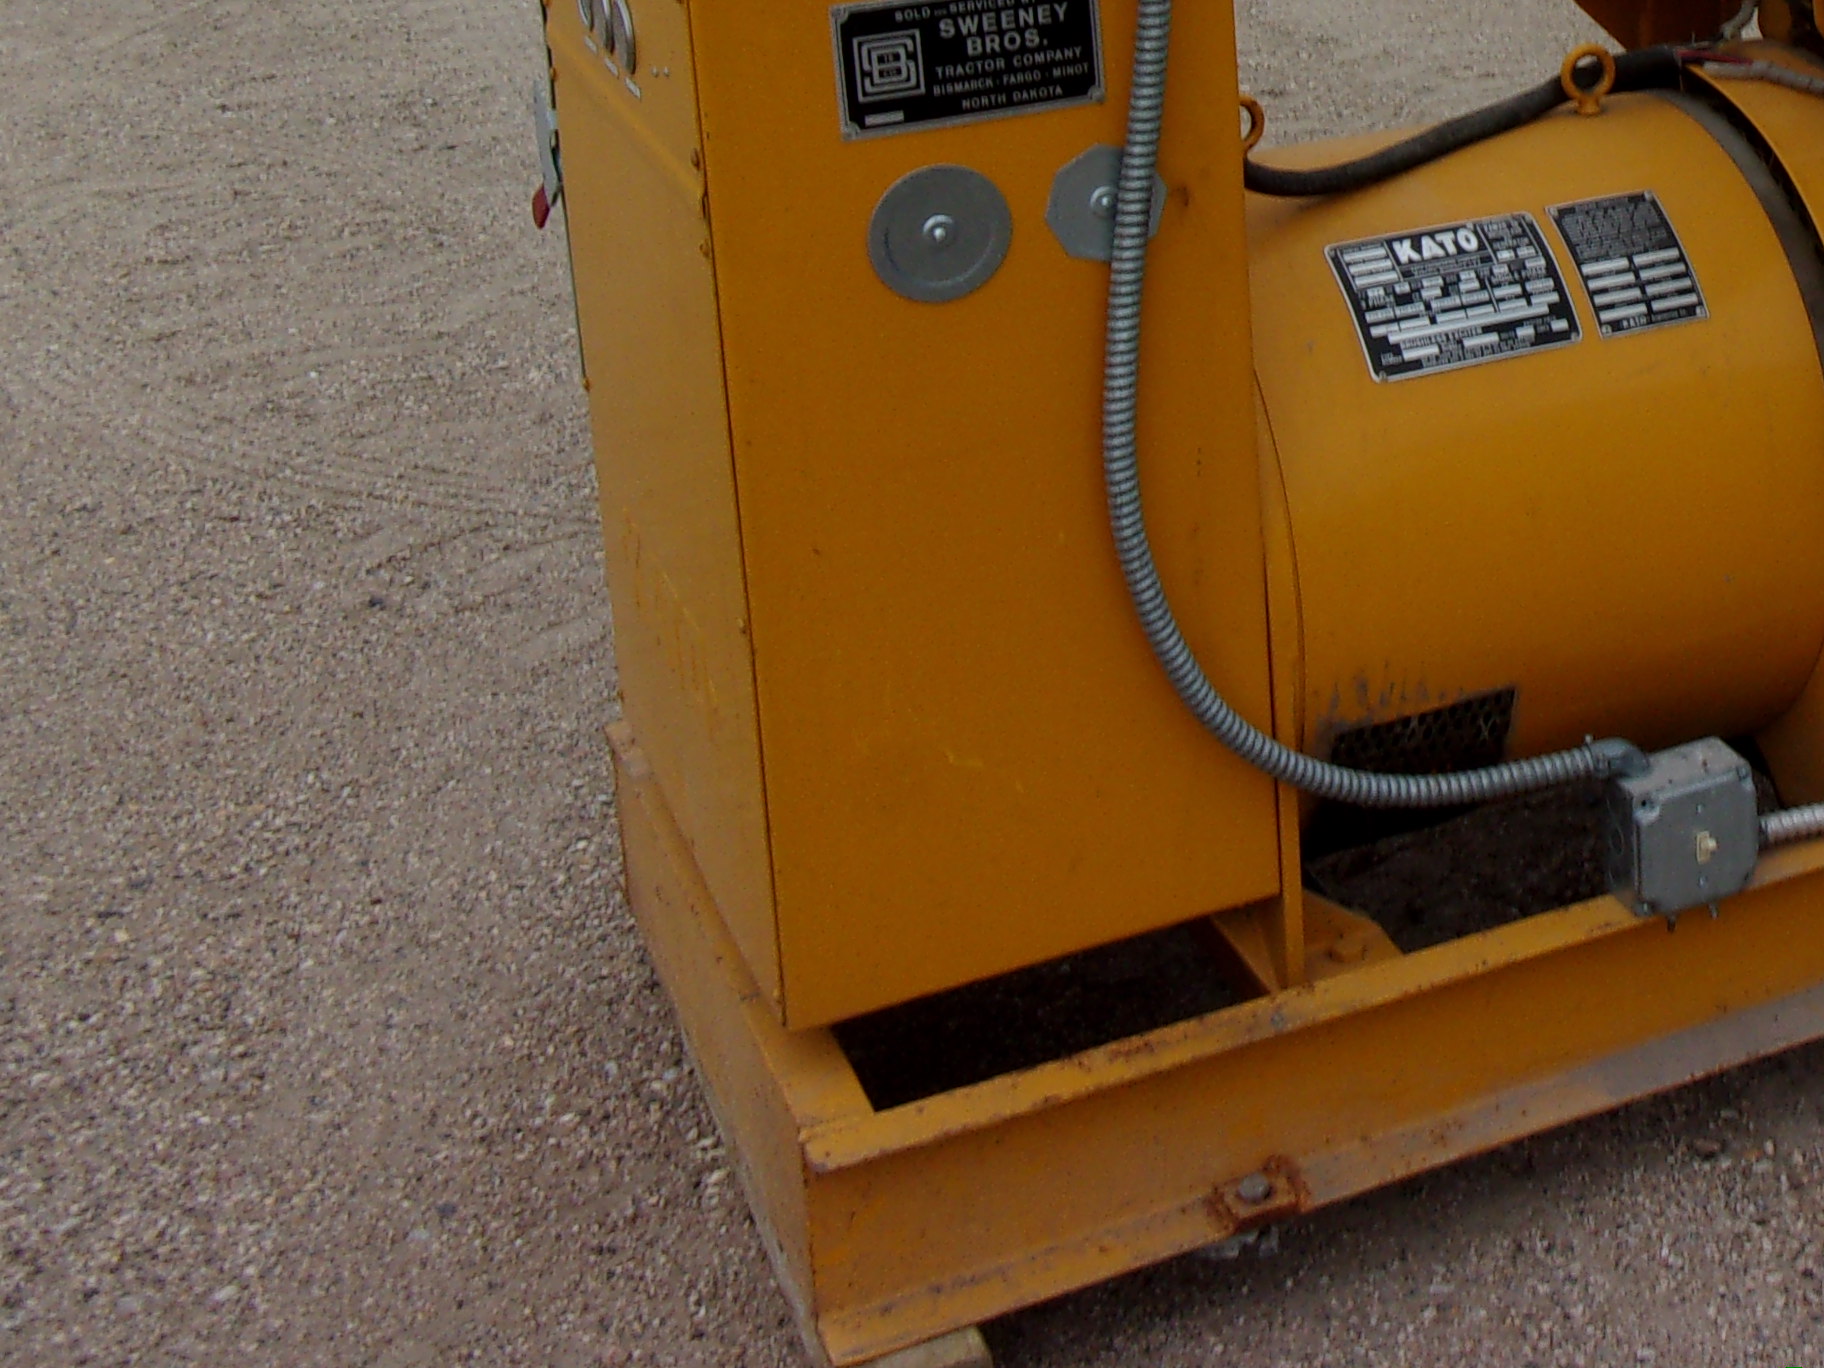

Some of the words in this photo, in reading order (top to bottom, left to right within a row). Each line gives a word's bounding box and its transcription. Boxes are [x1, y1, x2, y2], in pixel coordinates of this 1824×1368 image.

[894, 5, 931, 23] SOLD
[938, 1, 1068, 38] SWEENEY
[966, 29, 1048, 57] BROS.
[932, 76, 994, 97] BISMARCK
[1002, 70, 1042, 87] FARGO
[1052, 62, 1090, 80] MINOT
[935, 57, 1006, 80] TRACTOR
[1012, 46, 1082, 69] COMPANY
[962, 91, 1007, 111] NORTH
[1012, 84, 1064, 104] DAKOTA
[1392, 226, 1480, 265] KATO
